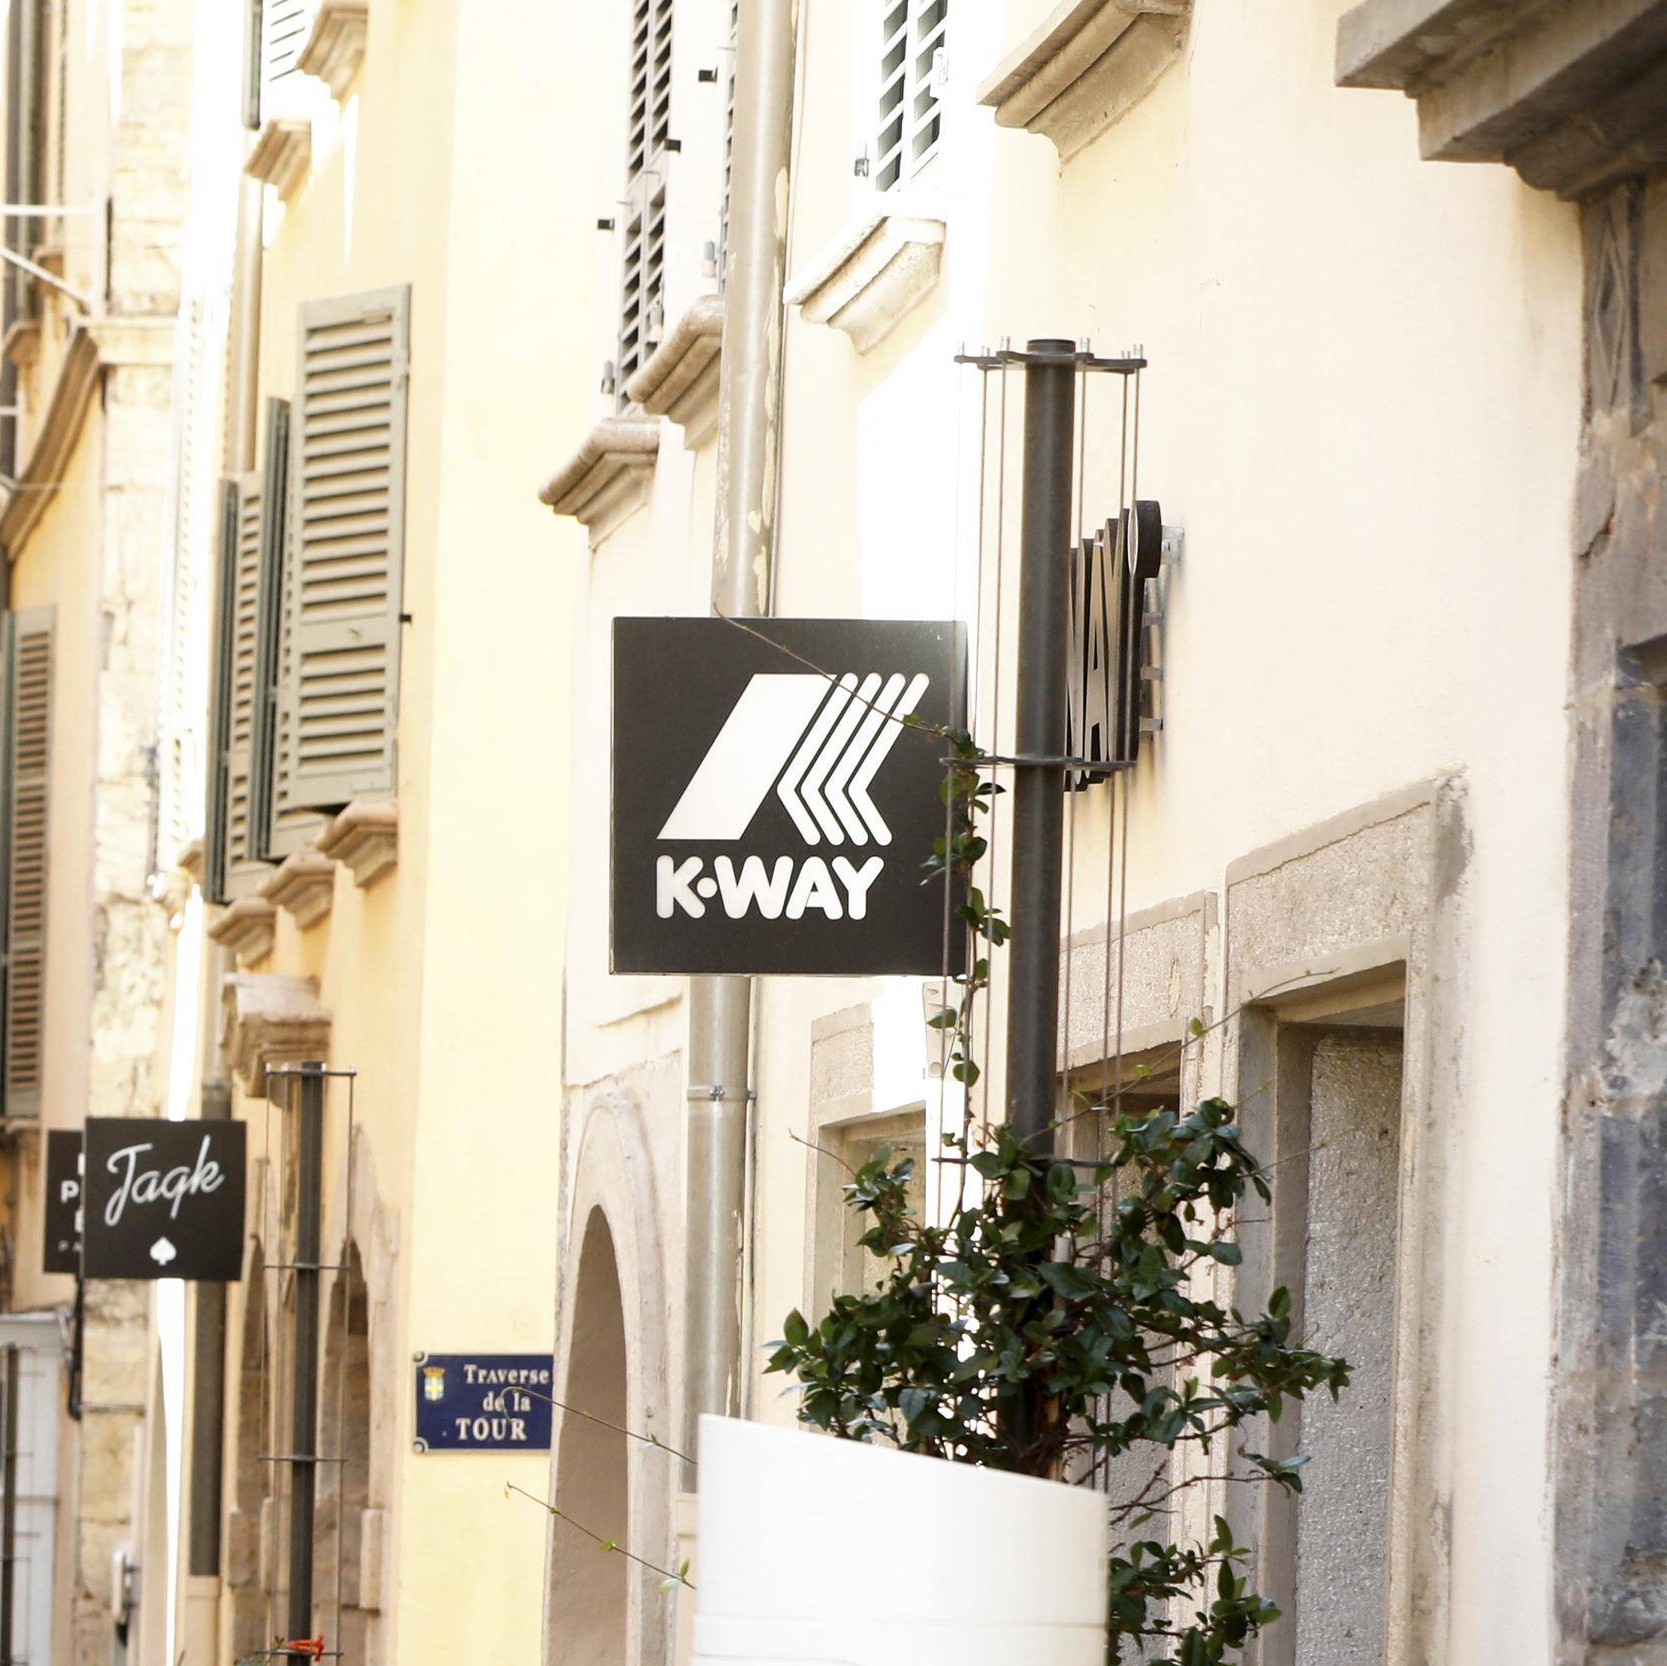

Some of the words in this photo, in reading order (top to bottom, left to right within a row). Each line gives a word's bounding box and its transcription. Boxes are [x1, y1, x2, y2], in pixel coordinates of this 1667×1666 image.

[463, 1363, 550, 1385] Traverse
[482, 1390, 505, 1412] de
[513, 1389, 531, 1412] la
[455, 1417, 527, 1441] TOUR
